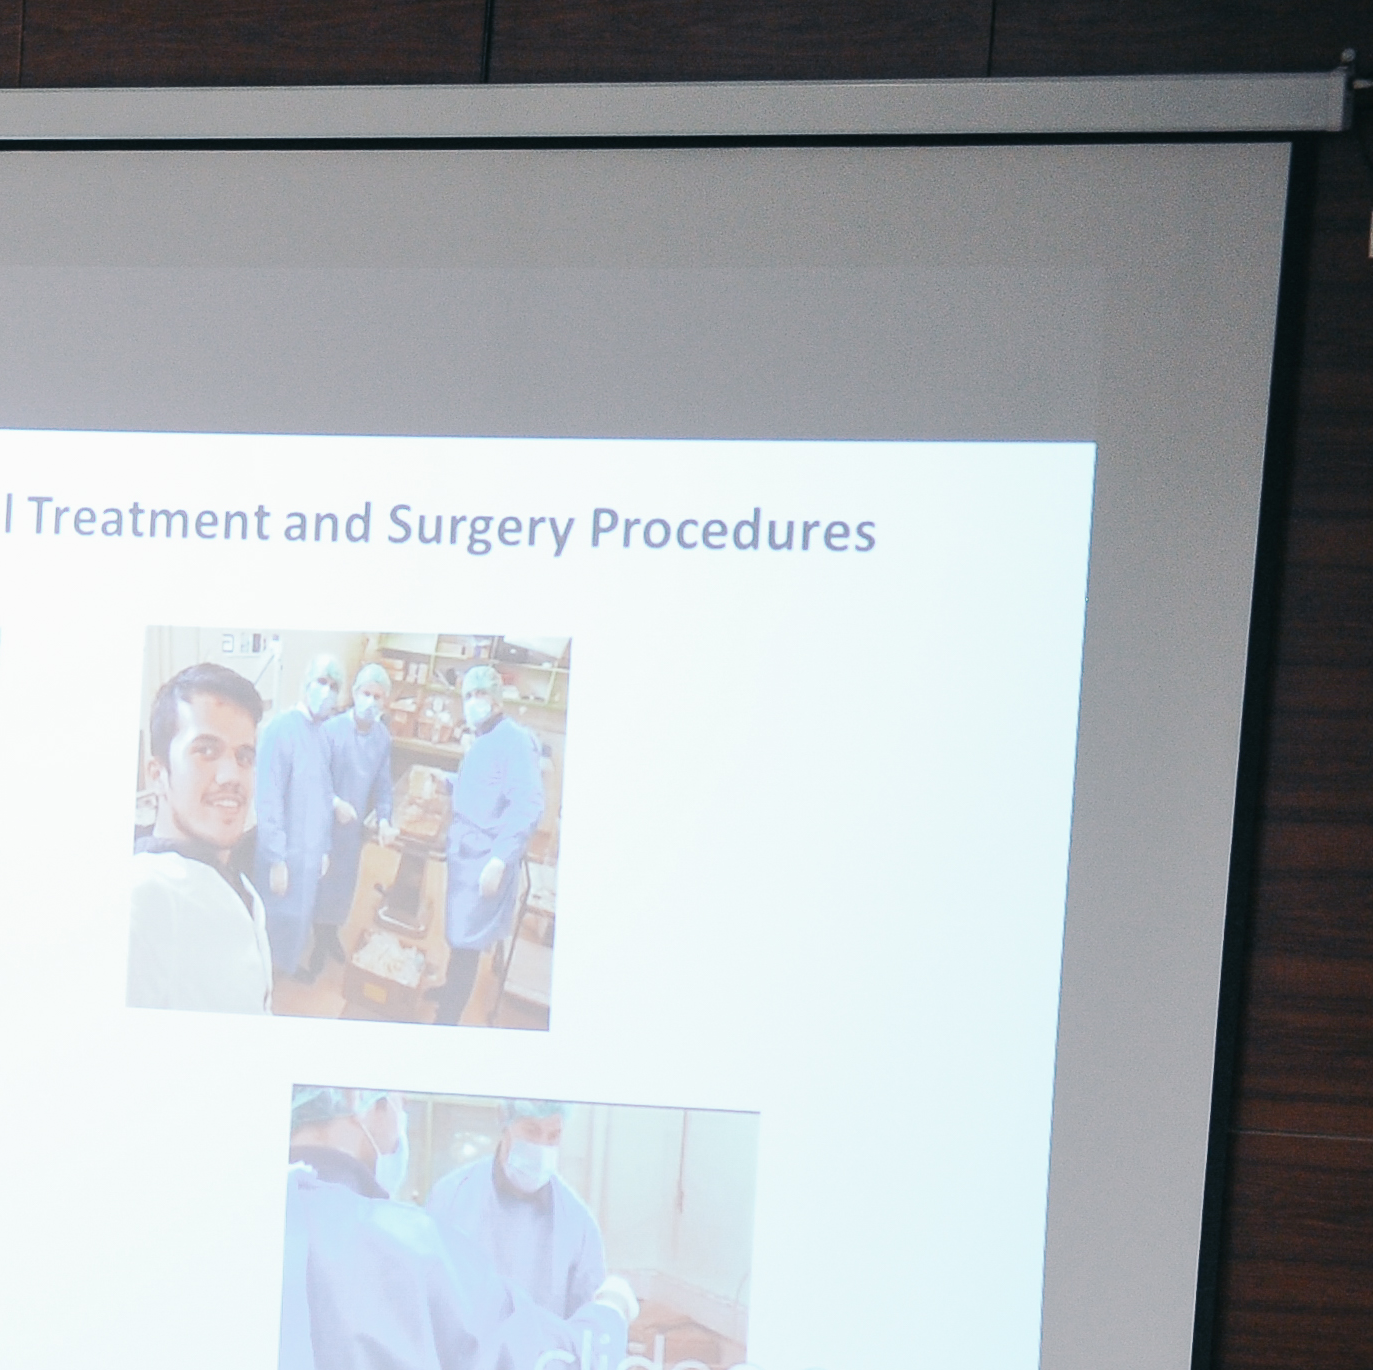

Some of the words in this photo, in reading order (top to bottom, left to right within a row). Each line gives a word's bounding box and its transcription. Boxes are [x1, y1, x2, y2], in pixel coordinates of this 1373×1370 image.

[27, 494, 272, 541] Treatment
[283, 500, 373, 544] and
[387, 502, 576, 558] Surgery
[590, 505, 878, 553] Procedures
